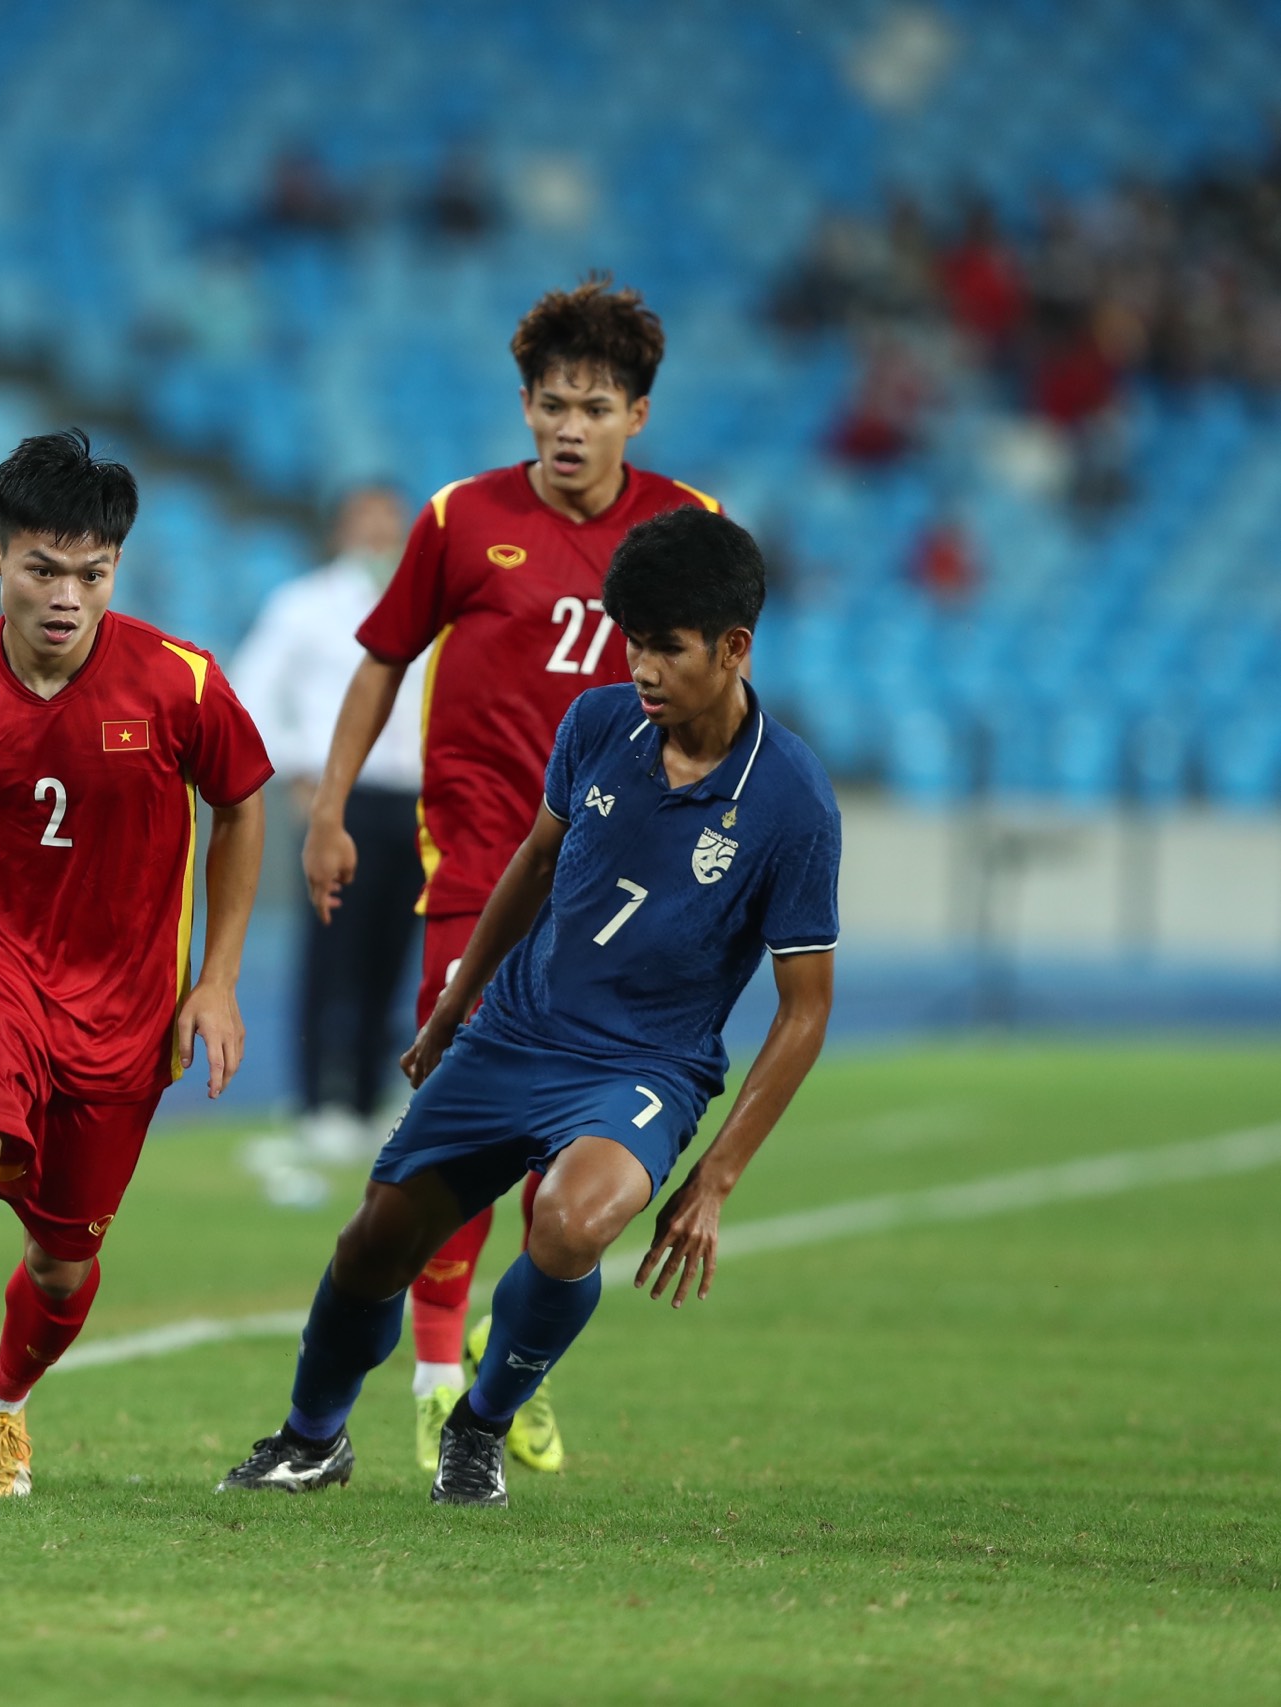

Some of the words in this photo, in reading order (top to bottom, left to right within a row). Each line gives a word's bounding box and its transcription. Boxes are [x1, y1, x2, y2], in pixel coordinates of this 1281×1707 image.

[545, 596, 615, 675] 27
[34, 777, 73, 847] 2
[703, 826, 739, 849] THAILAND
[592, 878, 649, 946] 7
[631, 1085, 663, 1129] 7
